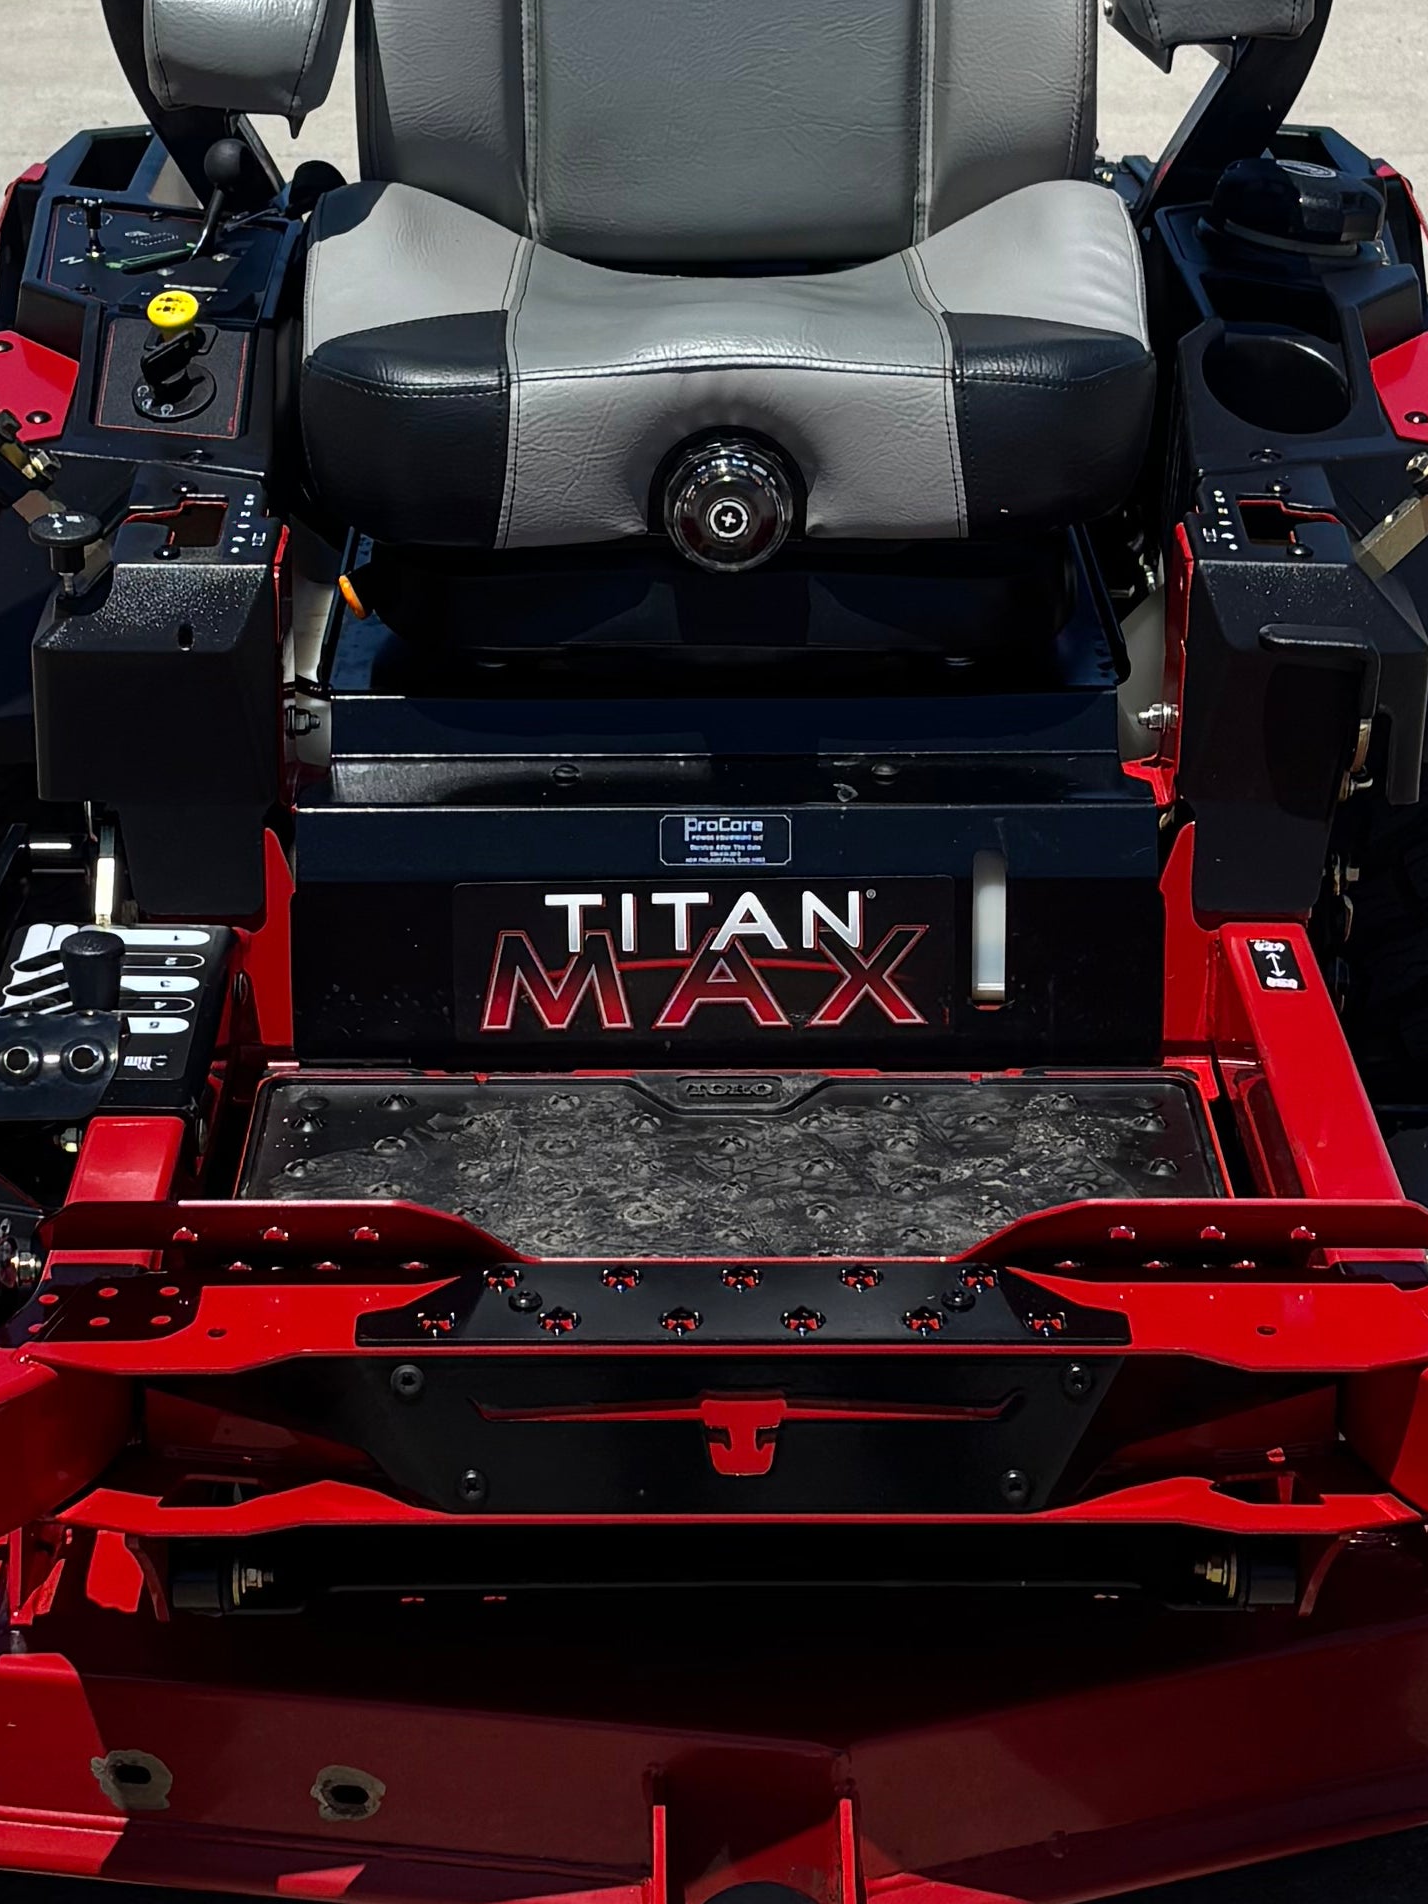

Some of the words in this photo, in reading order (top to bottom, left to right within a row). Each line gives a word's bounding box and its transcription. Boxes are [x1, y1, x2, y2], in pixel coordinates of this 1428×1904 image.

[684, 817, 764, 842] ProCore
[545, 891, 862, 953] TITAN
[480, 925, 931, 1032] MAX
